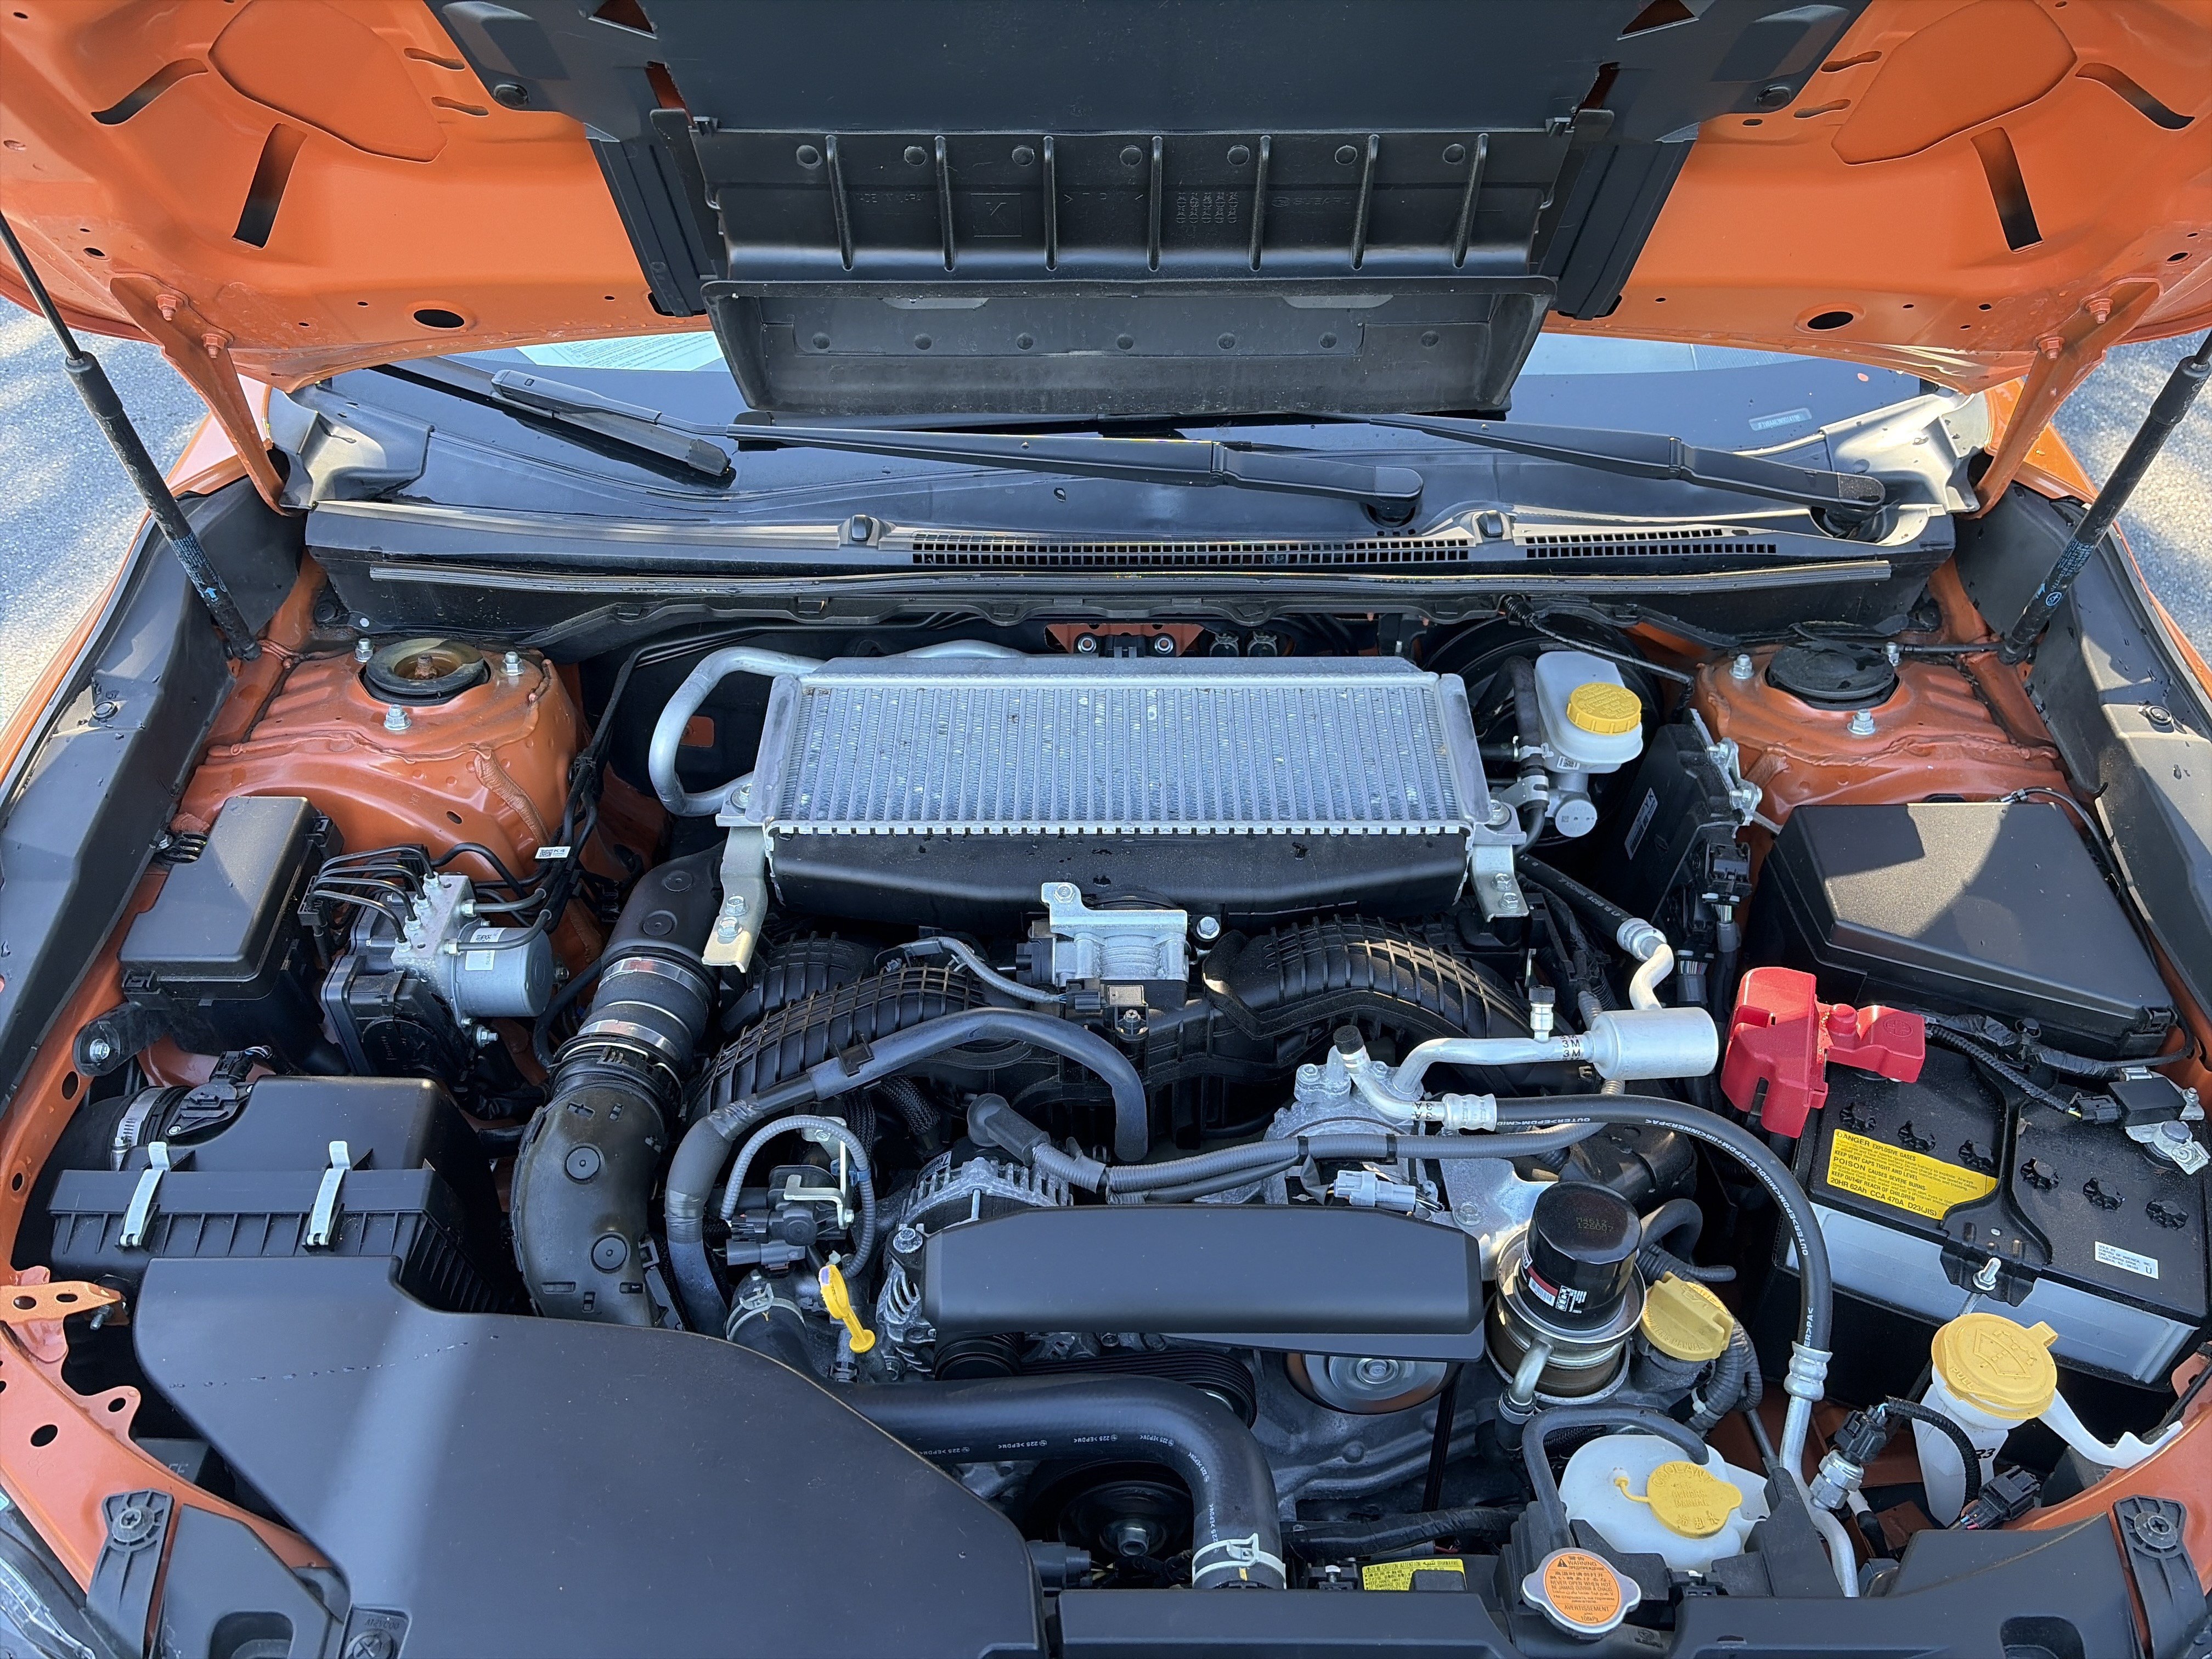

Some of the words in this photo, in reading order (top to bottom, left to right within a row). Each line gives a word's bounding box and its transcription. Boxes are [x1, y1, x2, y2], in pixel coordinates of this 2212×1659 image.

[1837, 1132, 1870, 1147] DANGER
[1872, 1144, 1899, 1156] EXPLOSIVE
[1900, 1153, 1916, 1161] GASES
[1833, 1156, 1865, 1171] POISON
[1868, 1168, 1887, 1178] CAUSES
[1889, 1175, 1907, 1185] SEVERE
[1861, 1158, 1875, 1166] CAPS
[1876, 1163, 1890, 1172] TIGHT
[1830, 1177, 1848, 1188] 20HR
[1850, 1183, 1866, 1193] 62Ah
[1870, 1190, 1886, 1201] CCA
[1887, 1195, 1904, 1206] 470A
[1908, 1202, 1938, 1217] D23(JIS)
[1864, 1181, 1881, 1190] REACH
[1890, 1189, 1915, 1201] CHILDREN
[1950, 1367, 1973, 1390] PULL
[1652, 1464, 1716, 1487] COOLANT
